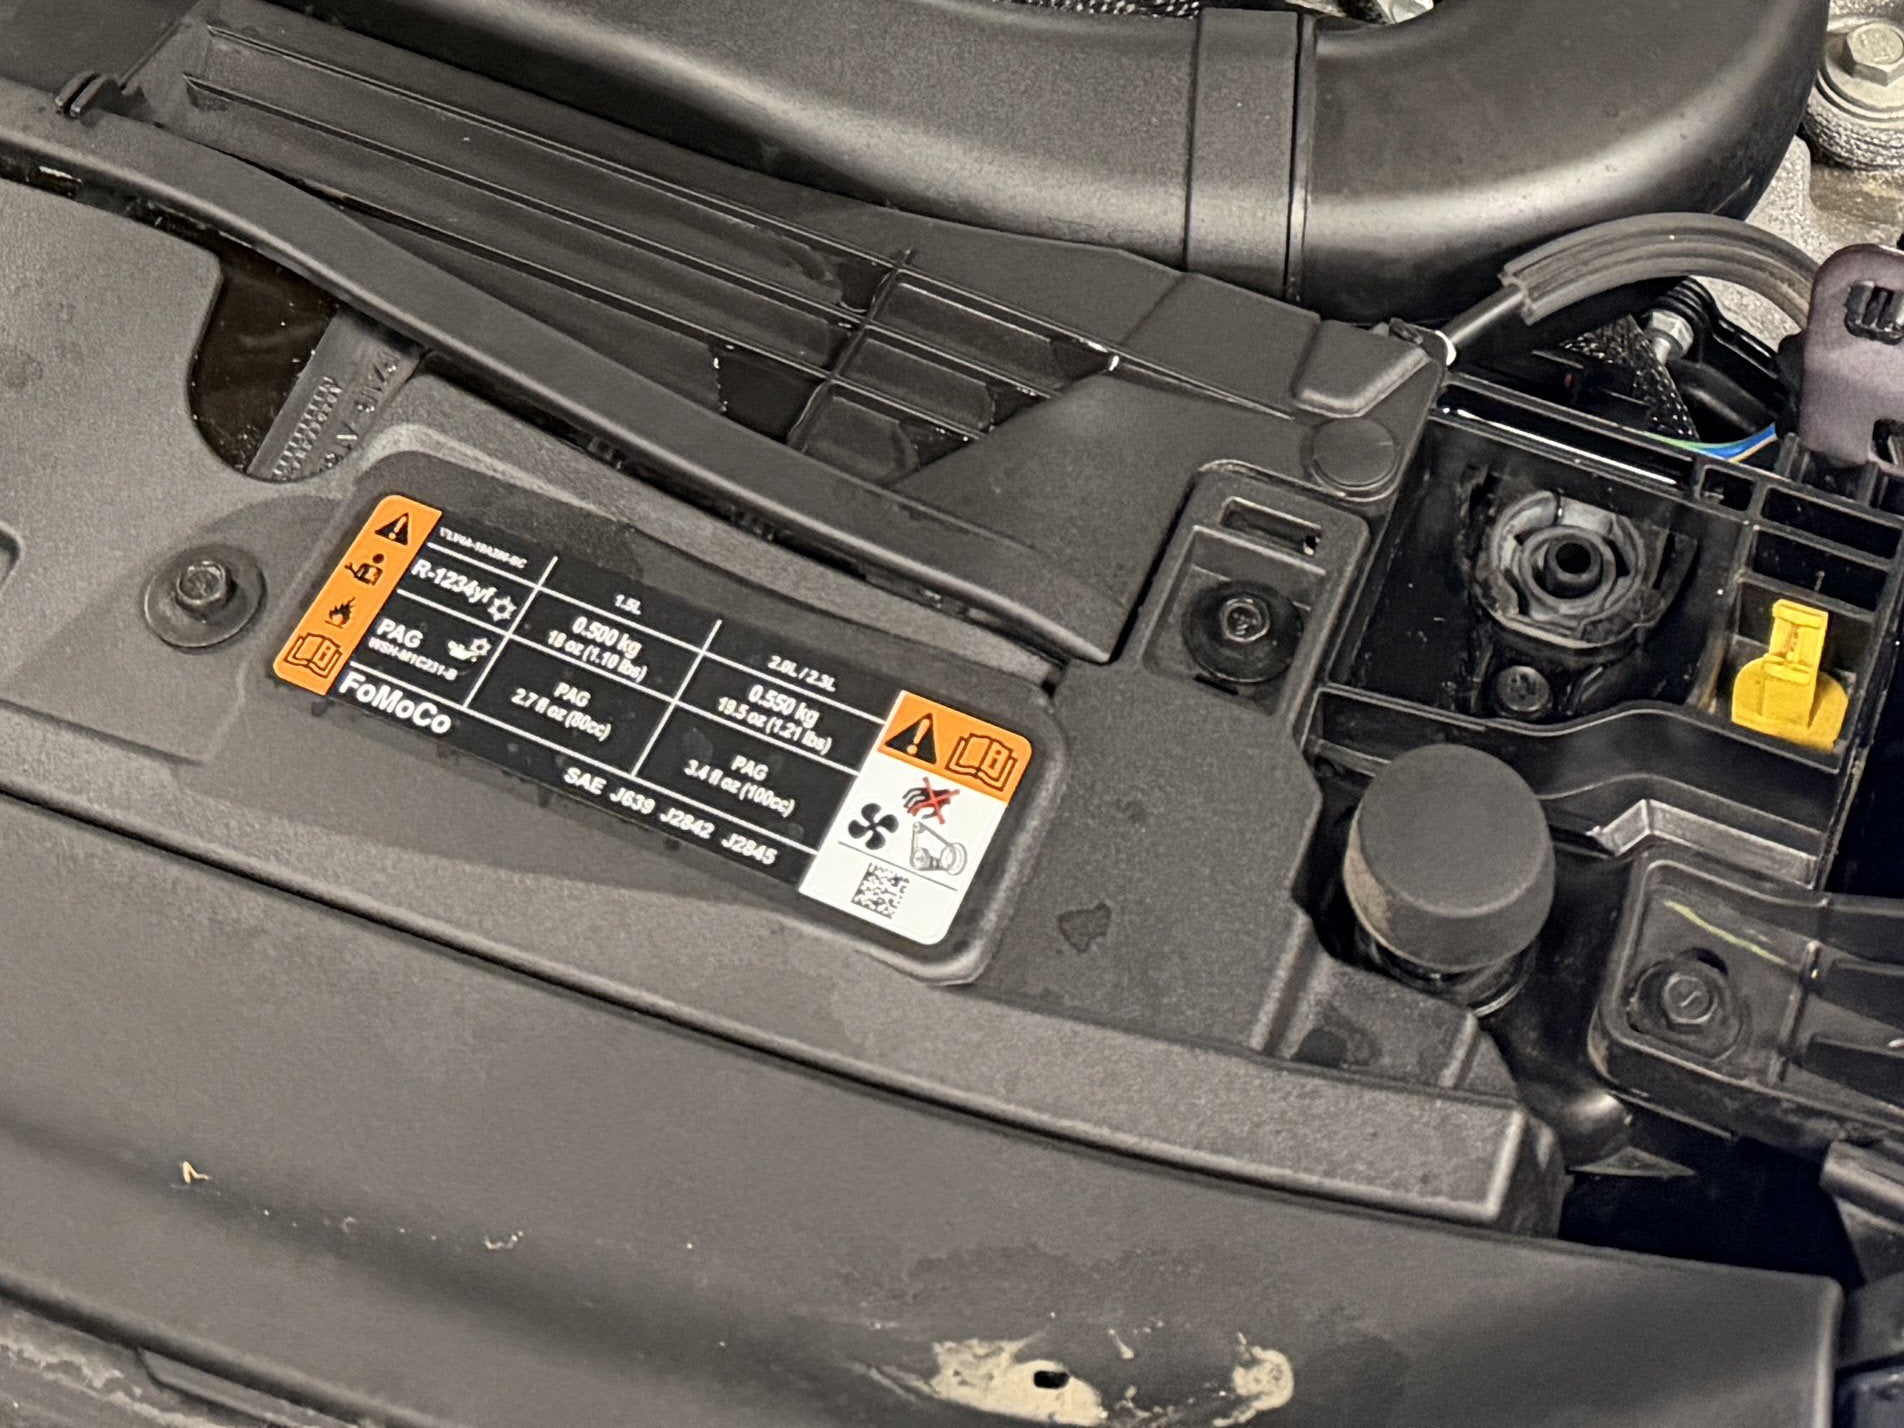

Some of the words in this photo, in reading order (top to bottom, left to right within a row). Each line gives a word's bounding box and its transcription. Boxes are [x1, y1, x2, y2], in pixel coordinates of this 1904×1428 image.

[411, 559, 496, 606] R-1234yf
[615, 594, 641, 615] 1.5L
[376, 618, 423, 648] PAG
[572, 616, 619, 648] 0.500
[616, 633, 642, 659] kg
[564, 637, 585, 656] oz
[580, 645, 620, 669] (1.10
[617, 657, 647, 683] lbs)
[338, 670, 451, 734] FoMoCo
[511, 688, 539, 707] 2.7
[565, 710, 611, 741] (80cc)
[553, 682, 591, 707] PAG
[748, 684, 797, 715] 0.550
[791, 702, 820, 729] kg
[718, 697, 750, 720] 19.5
[765, 717, 803, 741] (1.21
[801, 729, 832, 755] lbs)
[684, 759, 711, 780] 3.4
[739, 782, 795, 818] (100cc)
[731, 755, 768, 781] PAG
[563, 767, 607, 795] SAE
[609, 787, 656, 814] J639
[659, 807, 715, 839] J2842
[721, 833, 778, 864] J2845
